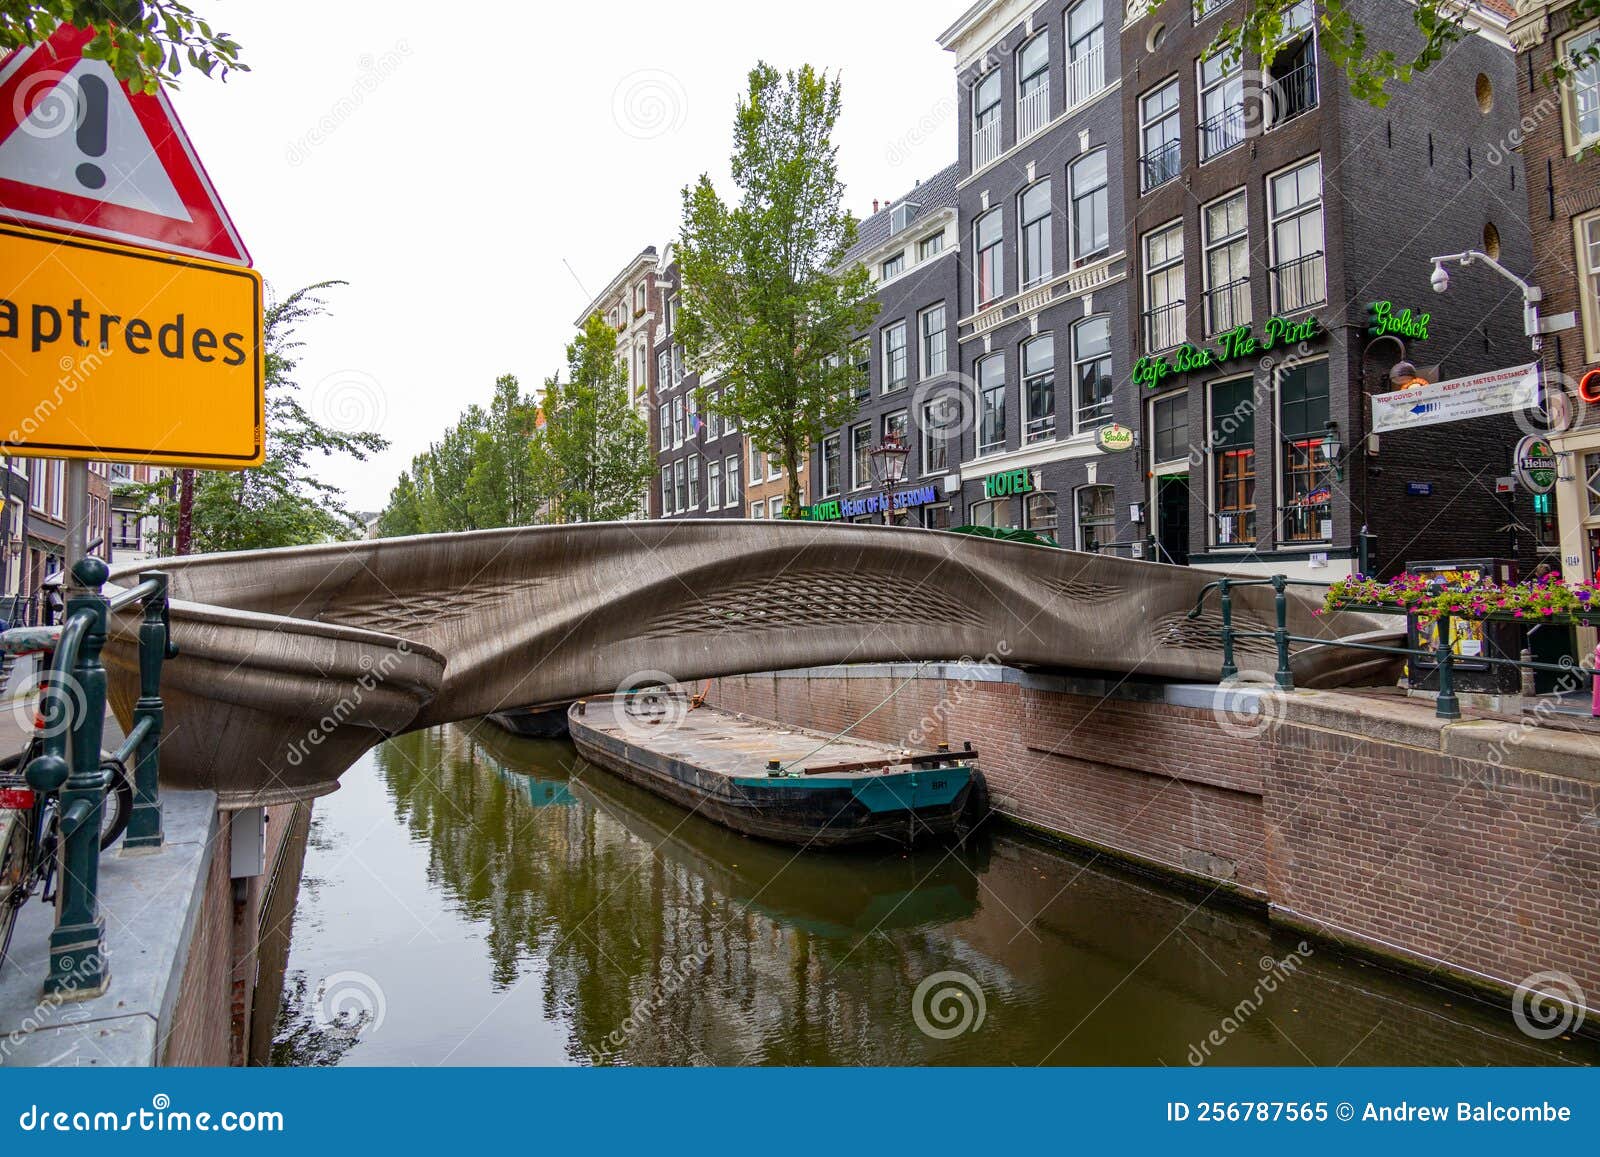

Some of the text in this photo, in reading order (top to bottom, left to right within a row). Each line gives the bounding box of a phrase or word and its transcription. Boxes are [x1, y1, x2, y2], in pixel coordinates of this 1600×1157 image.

[1376, 301, 1430, 339] Grolsch
[1132, 316, 1317, 388] Cafe Bar The Pint
[1394, 391, 1422, 400] COVID-19
[1473, 375, 1496, 385] METER
[1497, 369, 1529, 380] DISTANCE
[1104, 431, 1130, 443] Grolsch
[985, 467, 1033, 497] HOTEL
[814, 500, 841, 520] HOTEL
